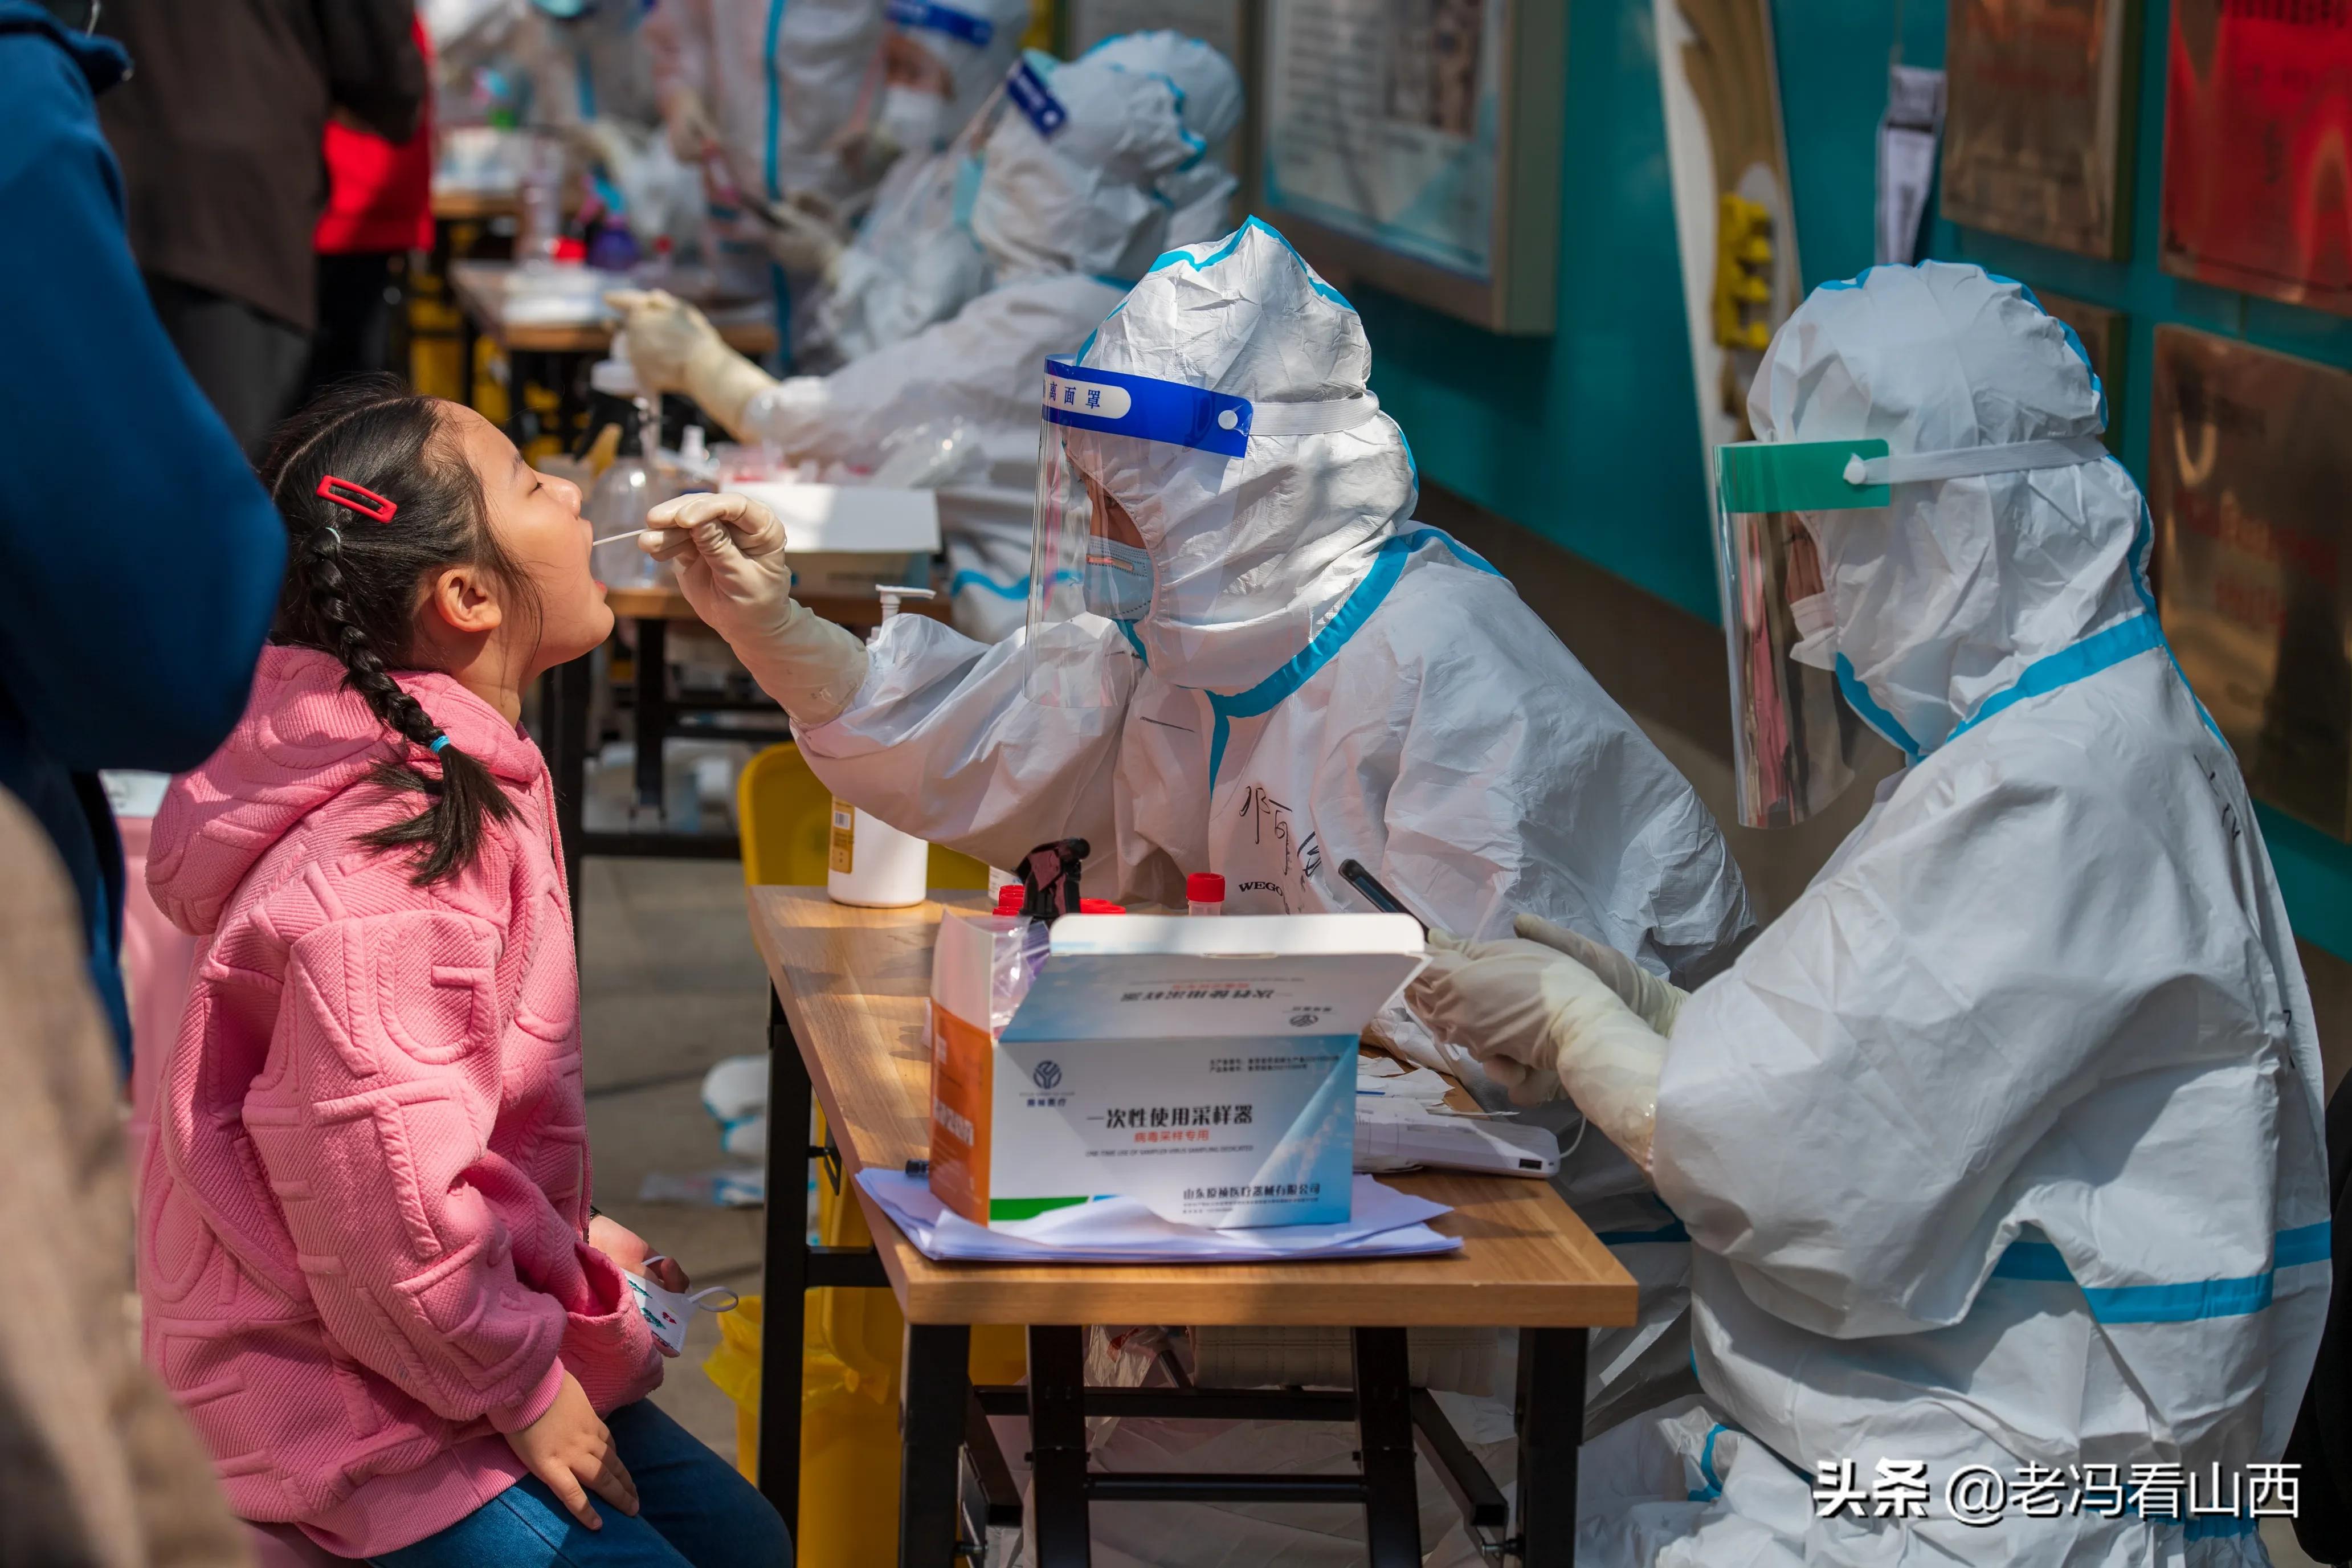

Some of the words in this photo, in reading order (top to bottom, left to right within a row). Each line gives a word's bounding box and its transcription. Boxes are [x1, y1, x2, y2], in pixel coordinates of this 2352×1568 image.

[1043, 379, 1101, 409] 离面罩
[1239, 881, 1283, 896] WEGO
[1087, 1105, 1252, 1129] 一次性使用采样器
[1134, 1129, 1209, 1143] 病毒采样专用
